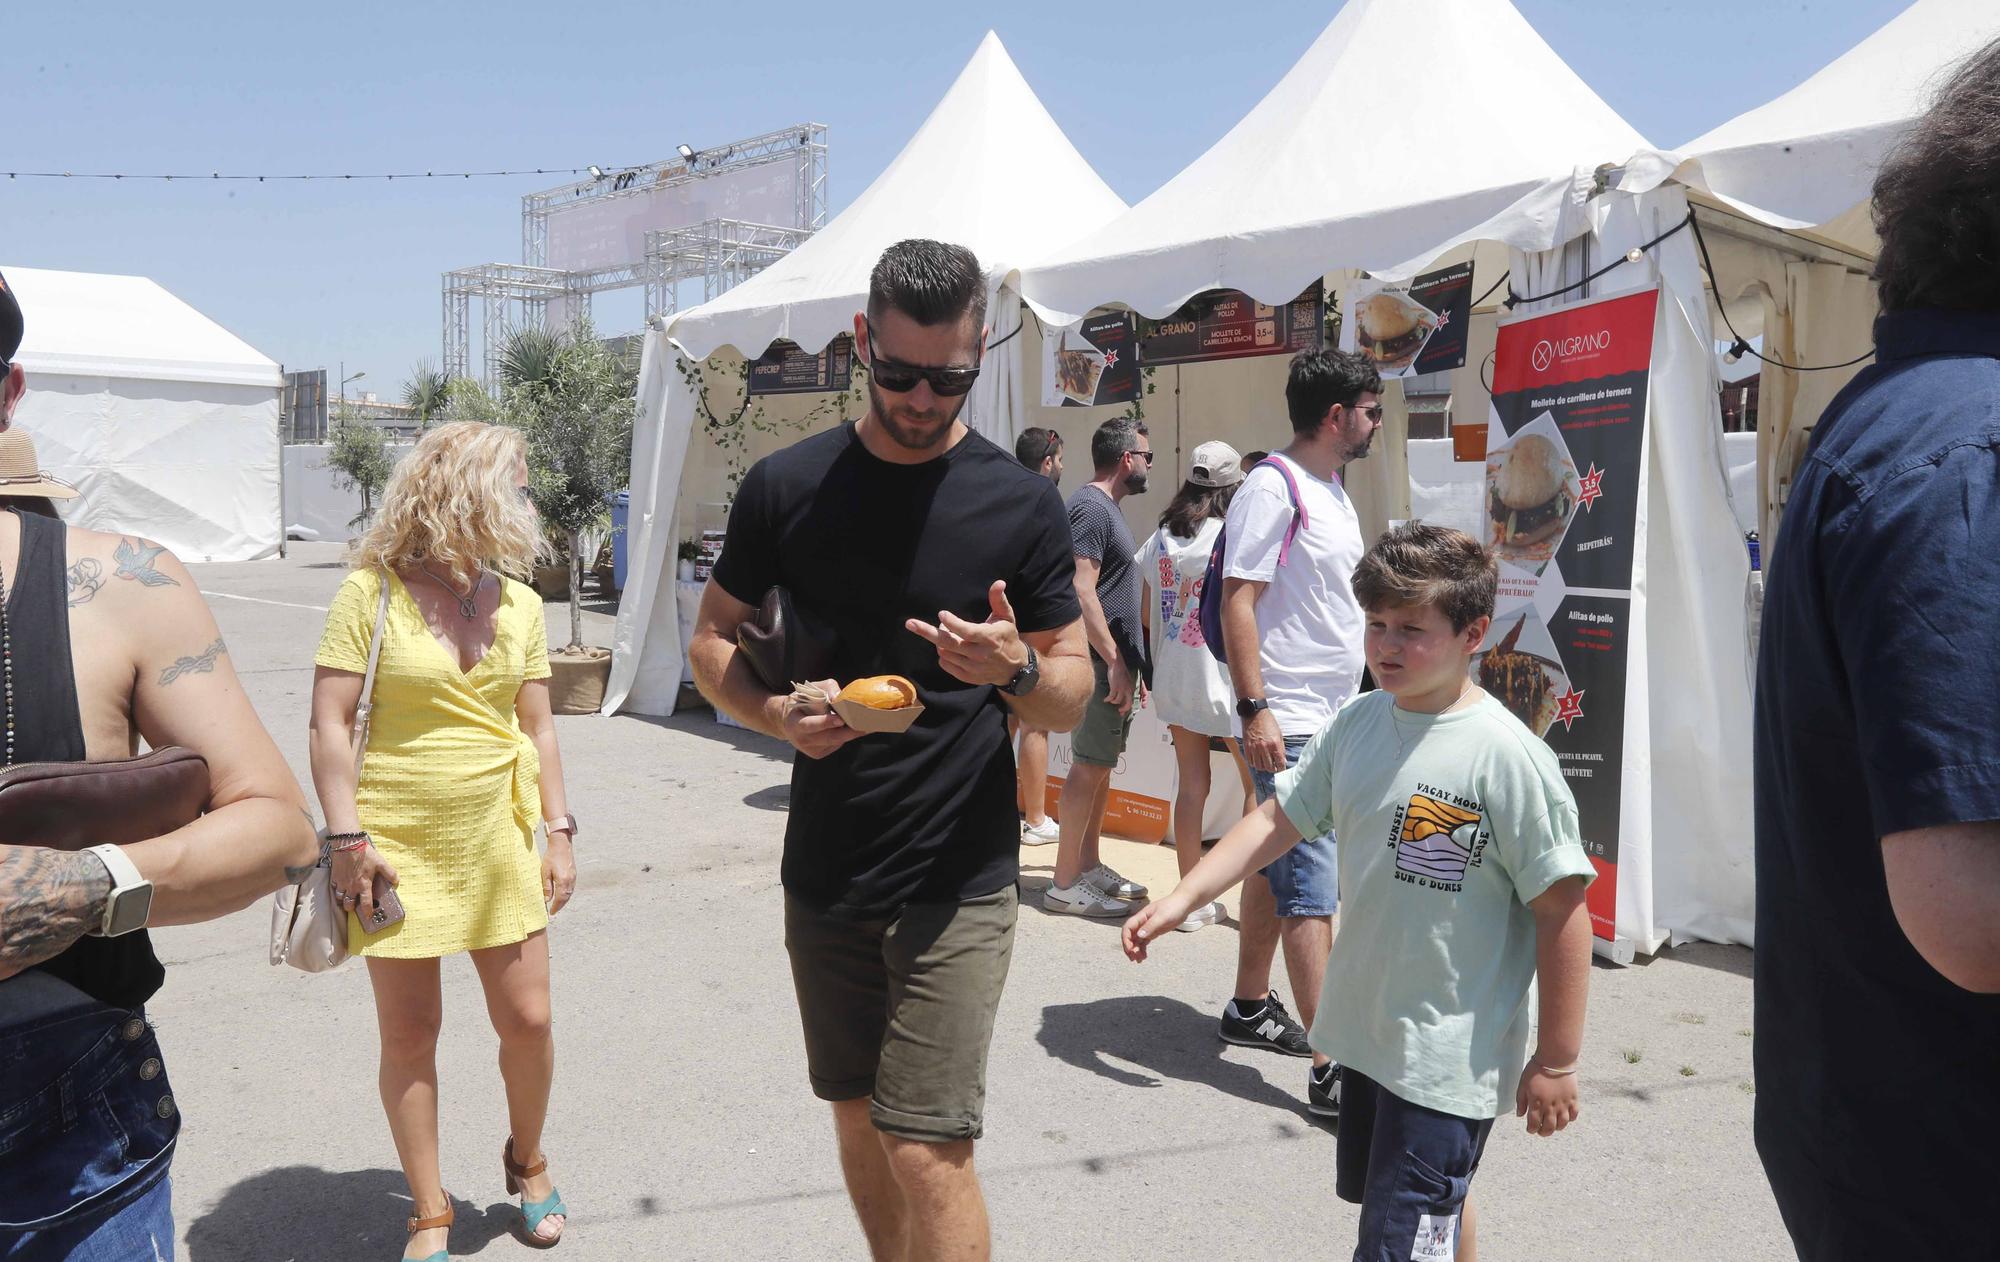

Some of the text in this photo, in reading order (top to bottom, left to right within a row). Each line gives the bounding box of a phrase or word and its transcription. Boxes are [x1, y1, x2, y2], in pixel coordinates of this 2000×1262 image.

[1231, 301, 1238, 309] DE
[1217, 309, 1235, 318] POLLO
[1160, 321, 1196, 337] GRANO
[1211, 330, 1233, 338] MOLLETE
[1203, 336, 1233, 346] CARRILLERA
[1552, 330, 1610, 358] ALGRANO
[1531, 387, 1632, 408] Mollete de carrillera de ternera
[1584, 479, 1596, 490] 3,5
[1568, 611, 1614, 624] Alitas de pollo
[1567, 698, 1573, 708] 3
[1418, 782, 1484, 812] VACAY MOOD
[1388, 804, 1404, 848] SUNSET
[1470, 831, 1490, 868] PLEASE
[1394, 871, 1416, 884] SUN
[1430, 882, 1462, 892] DUNES
